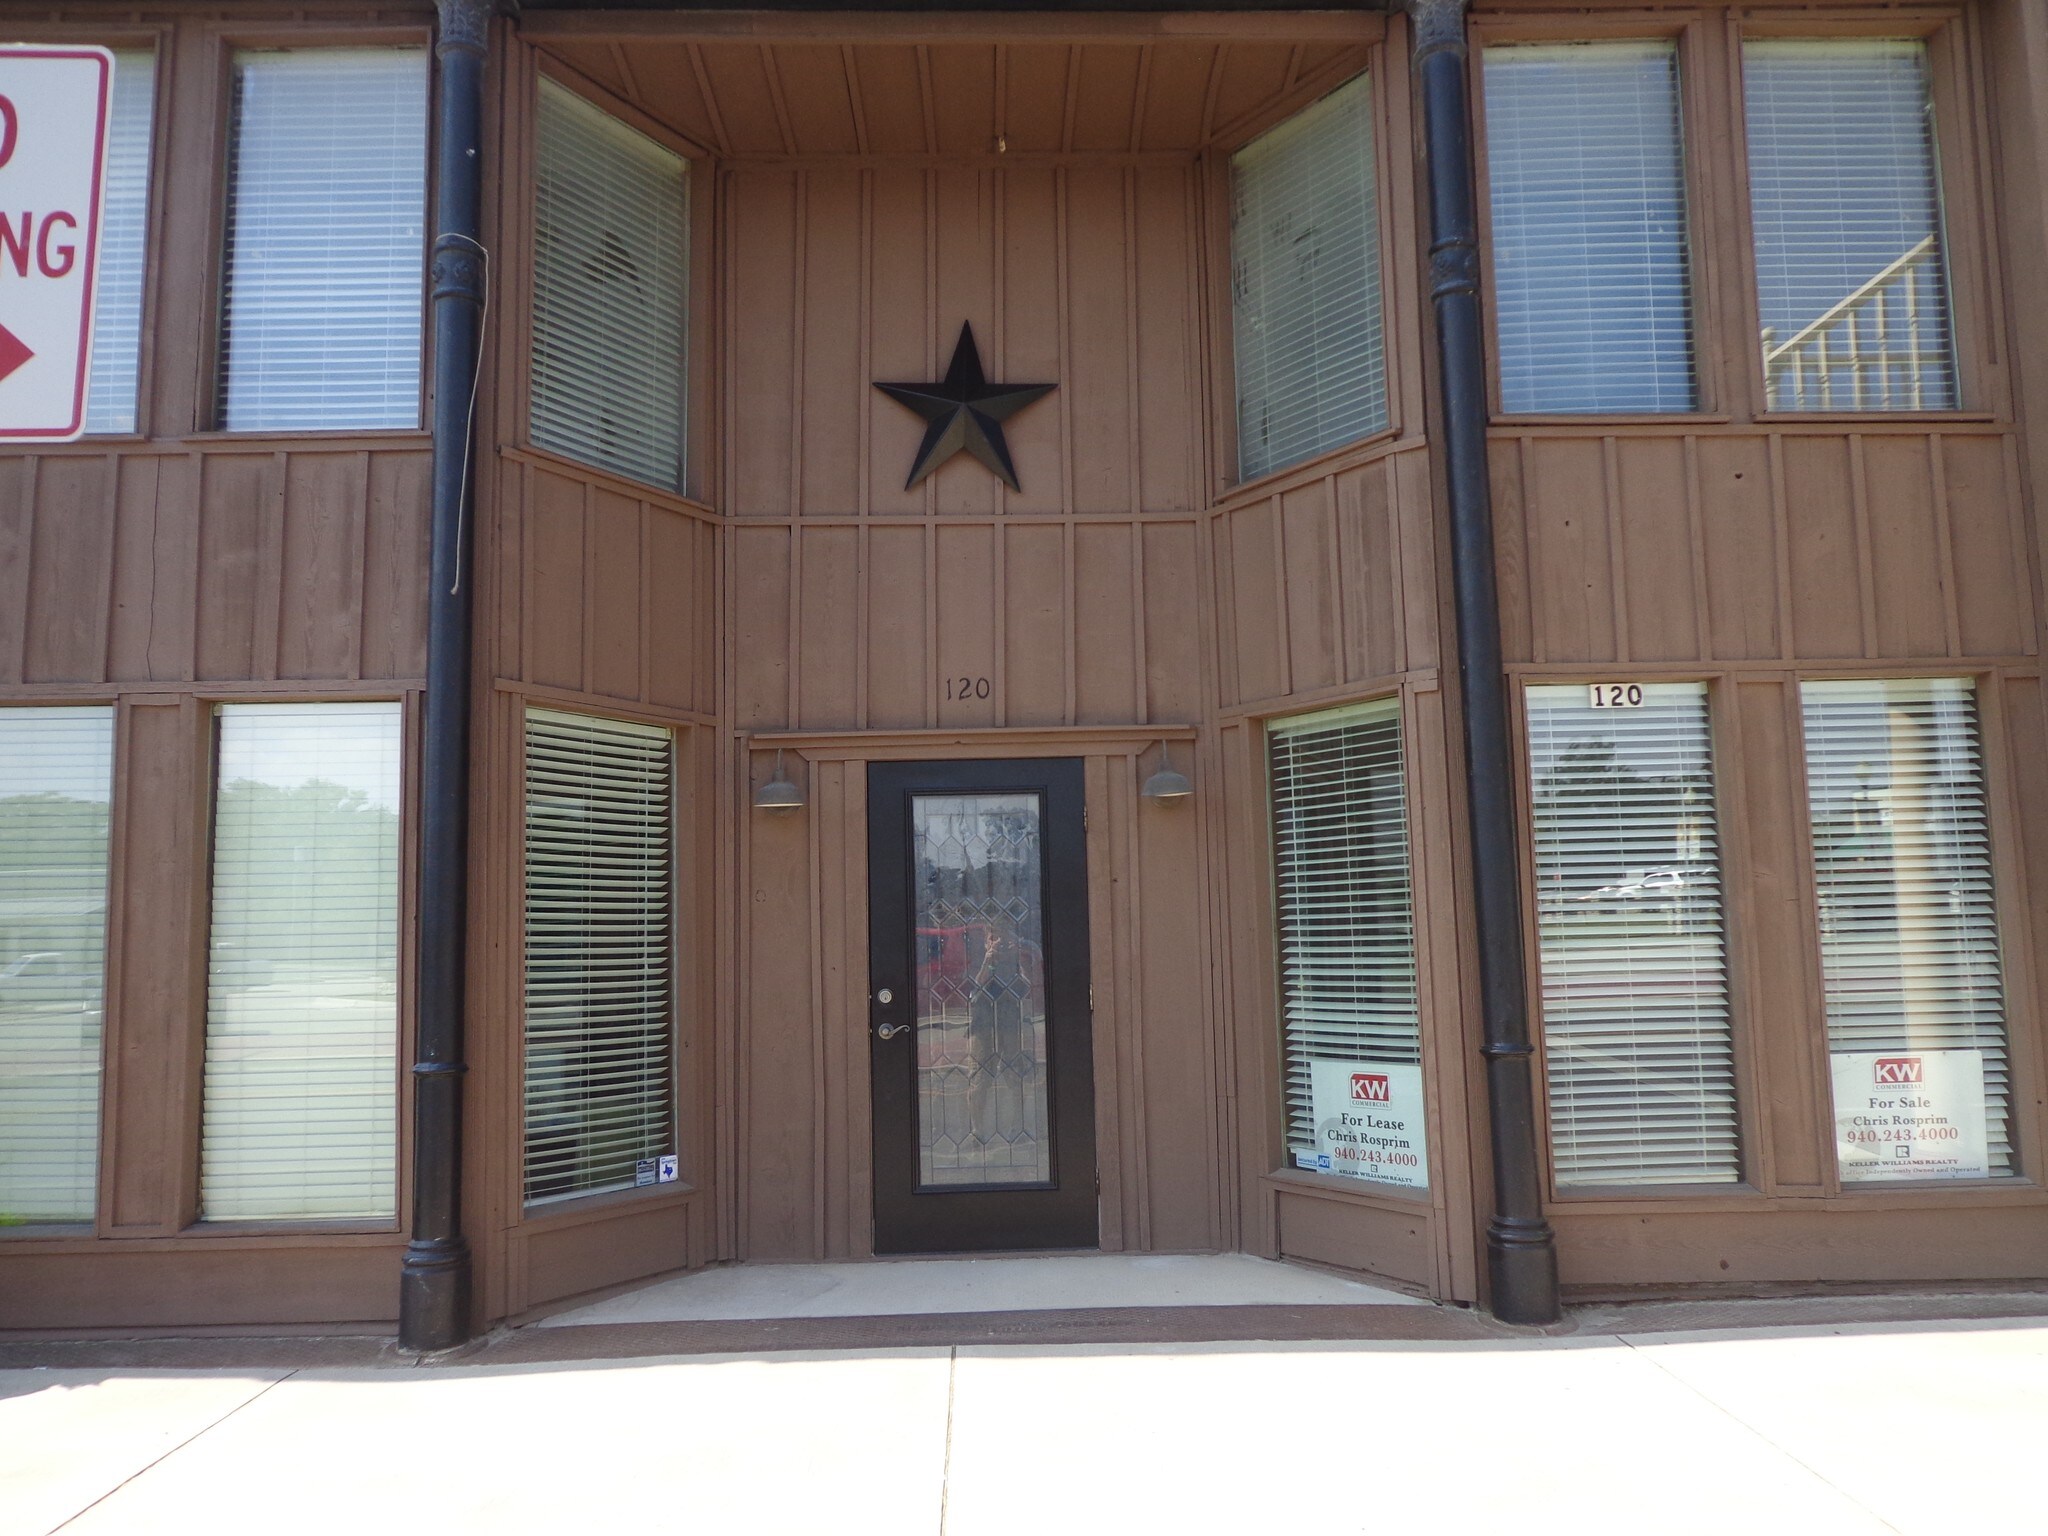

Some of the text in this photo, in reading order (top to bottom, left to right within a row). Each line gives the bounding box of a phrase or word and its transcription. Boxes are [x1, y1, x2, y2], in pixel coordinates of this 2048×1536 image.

[946, 677, 990, 701] 120
[1595, 684, 1643, 707] 120
[1875, 1063, 1921, 1082] KW
[1352, 1079, 1387, 1100] KW
[1352, 1100, 1390, 1108] COMMERCIAL
[1869, 1097, 1931, 1109] For Sale
[1341, 1113, 1405, 1130] For Lease
[1853, 1114, 1948, 1127] Chris Rosprim
[1327, 1129, 1410, 1149] Chris Rosprim
[1847, 1127, 1958, 1143] 940.243.4000
[1334, 1147, 1418, 1167] 940.243.4000
[1360, 1172, 1389, 1180] WILLIAMS
[1390, 1175, 1413, 1183] REALTY
